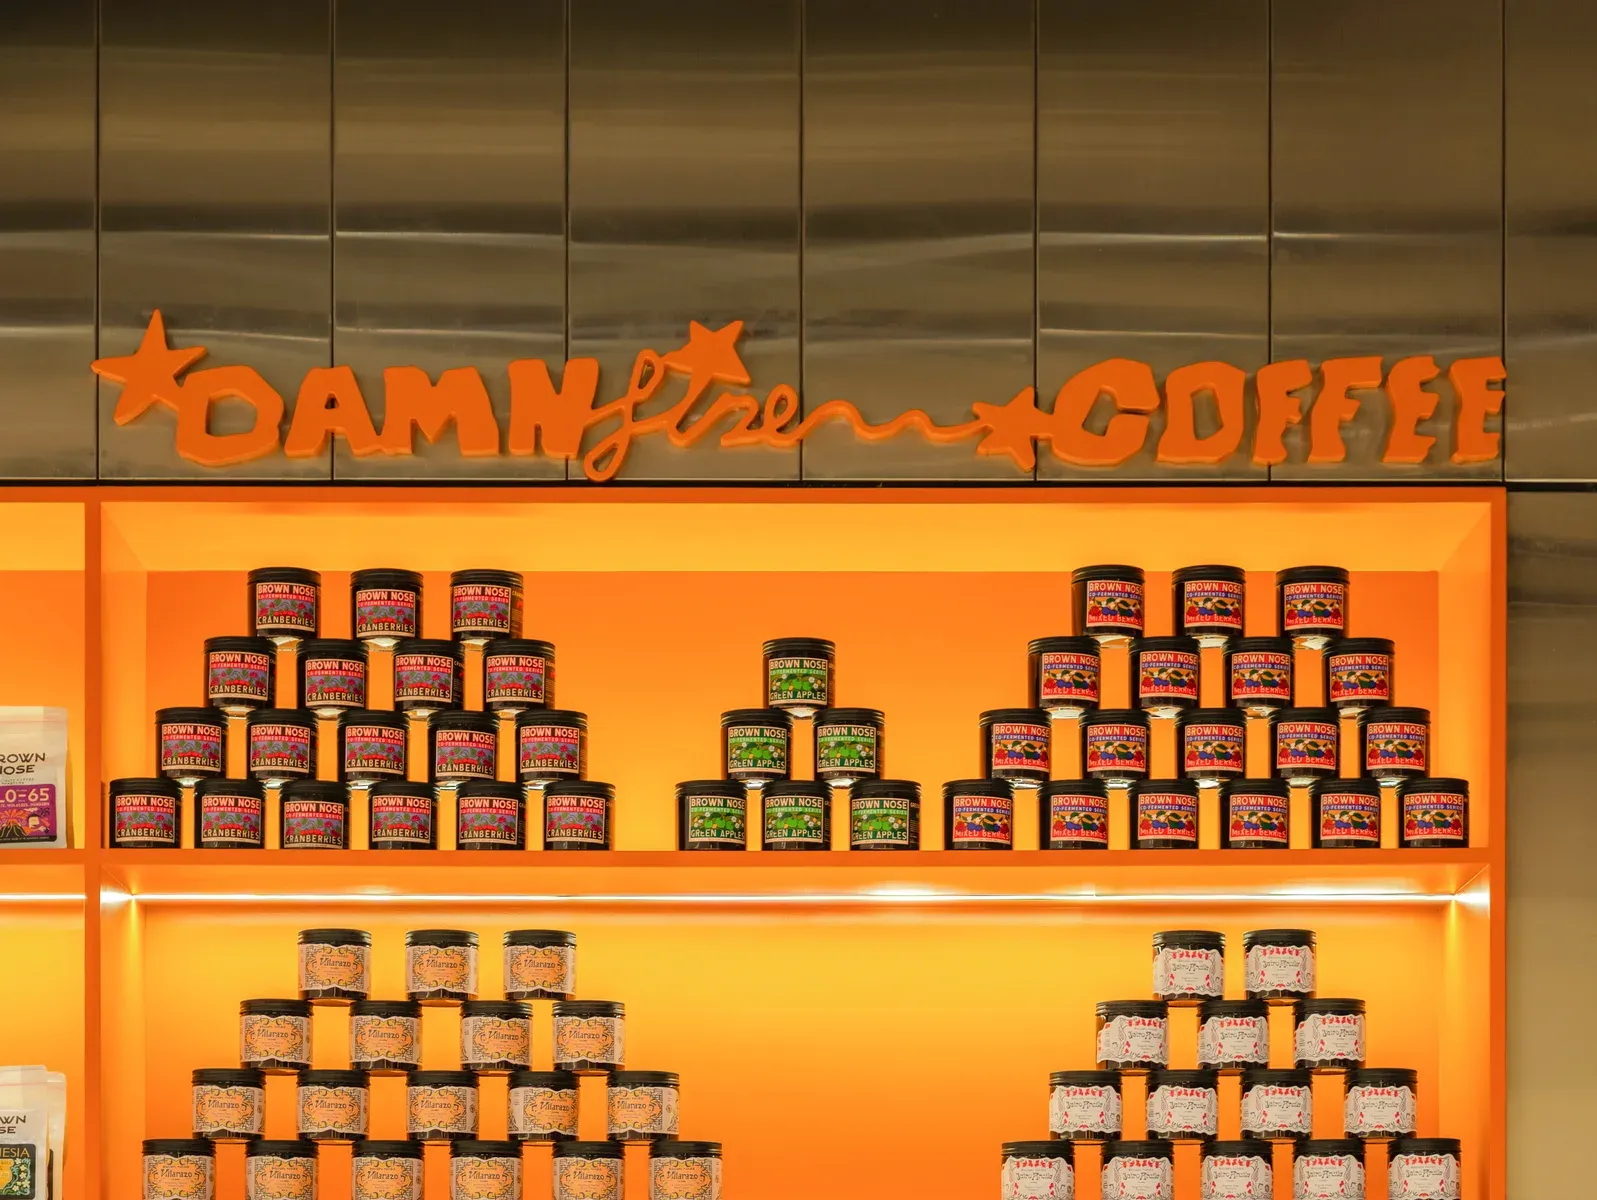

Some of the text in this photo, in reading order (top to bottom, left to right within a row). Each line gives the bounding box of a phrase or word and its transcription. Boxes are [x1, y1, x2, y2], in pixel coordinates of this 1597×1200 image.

[175, 357, 600, 468] DAMN
[1050, 356, 1506, 466] COFFEE
[258, 585, 314, 596] BROWN NOSE
[258, 616, 314, 625] CRANBERRIES
[1143, 653, 1197, 664] BROWN NOSE
[308, 661, 364, 672] BROWN NOSE
[769, 660, 825, 669] BROWN NOSE
[307, 692, 363, 702] CRANBERRIES
[770, 691, 824, 700] GREEN APPLES
[163, 725, 219, 736] BROWN NOSE
[729, 728, 785, 738] BROWN NOSE
[1090, 726, 1145, 736] BROWN NOSE
[438, 732, 494, 744] BROWN NOSE
[162, 757, 219, 766] CRANBERRIES
[730, 759, 785, 769] GREEN APPLES
[0, 764, 35, 775] OSE
[437, 764, 494, 773] CRANBERRIES
[204, 798, 260, 809] BROWN NOSE
[1406, 795, 1462, 805] BROWN NOSE
[203, 829, 260, 838] CRANBERRIES
[0, 1147, 30, 1157] ESIA
